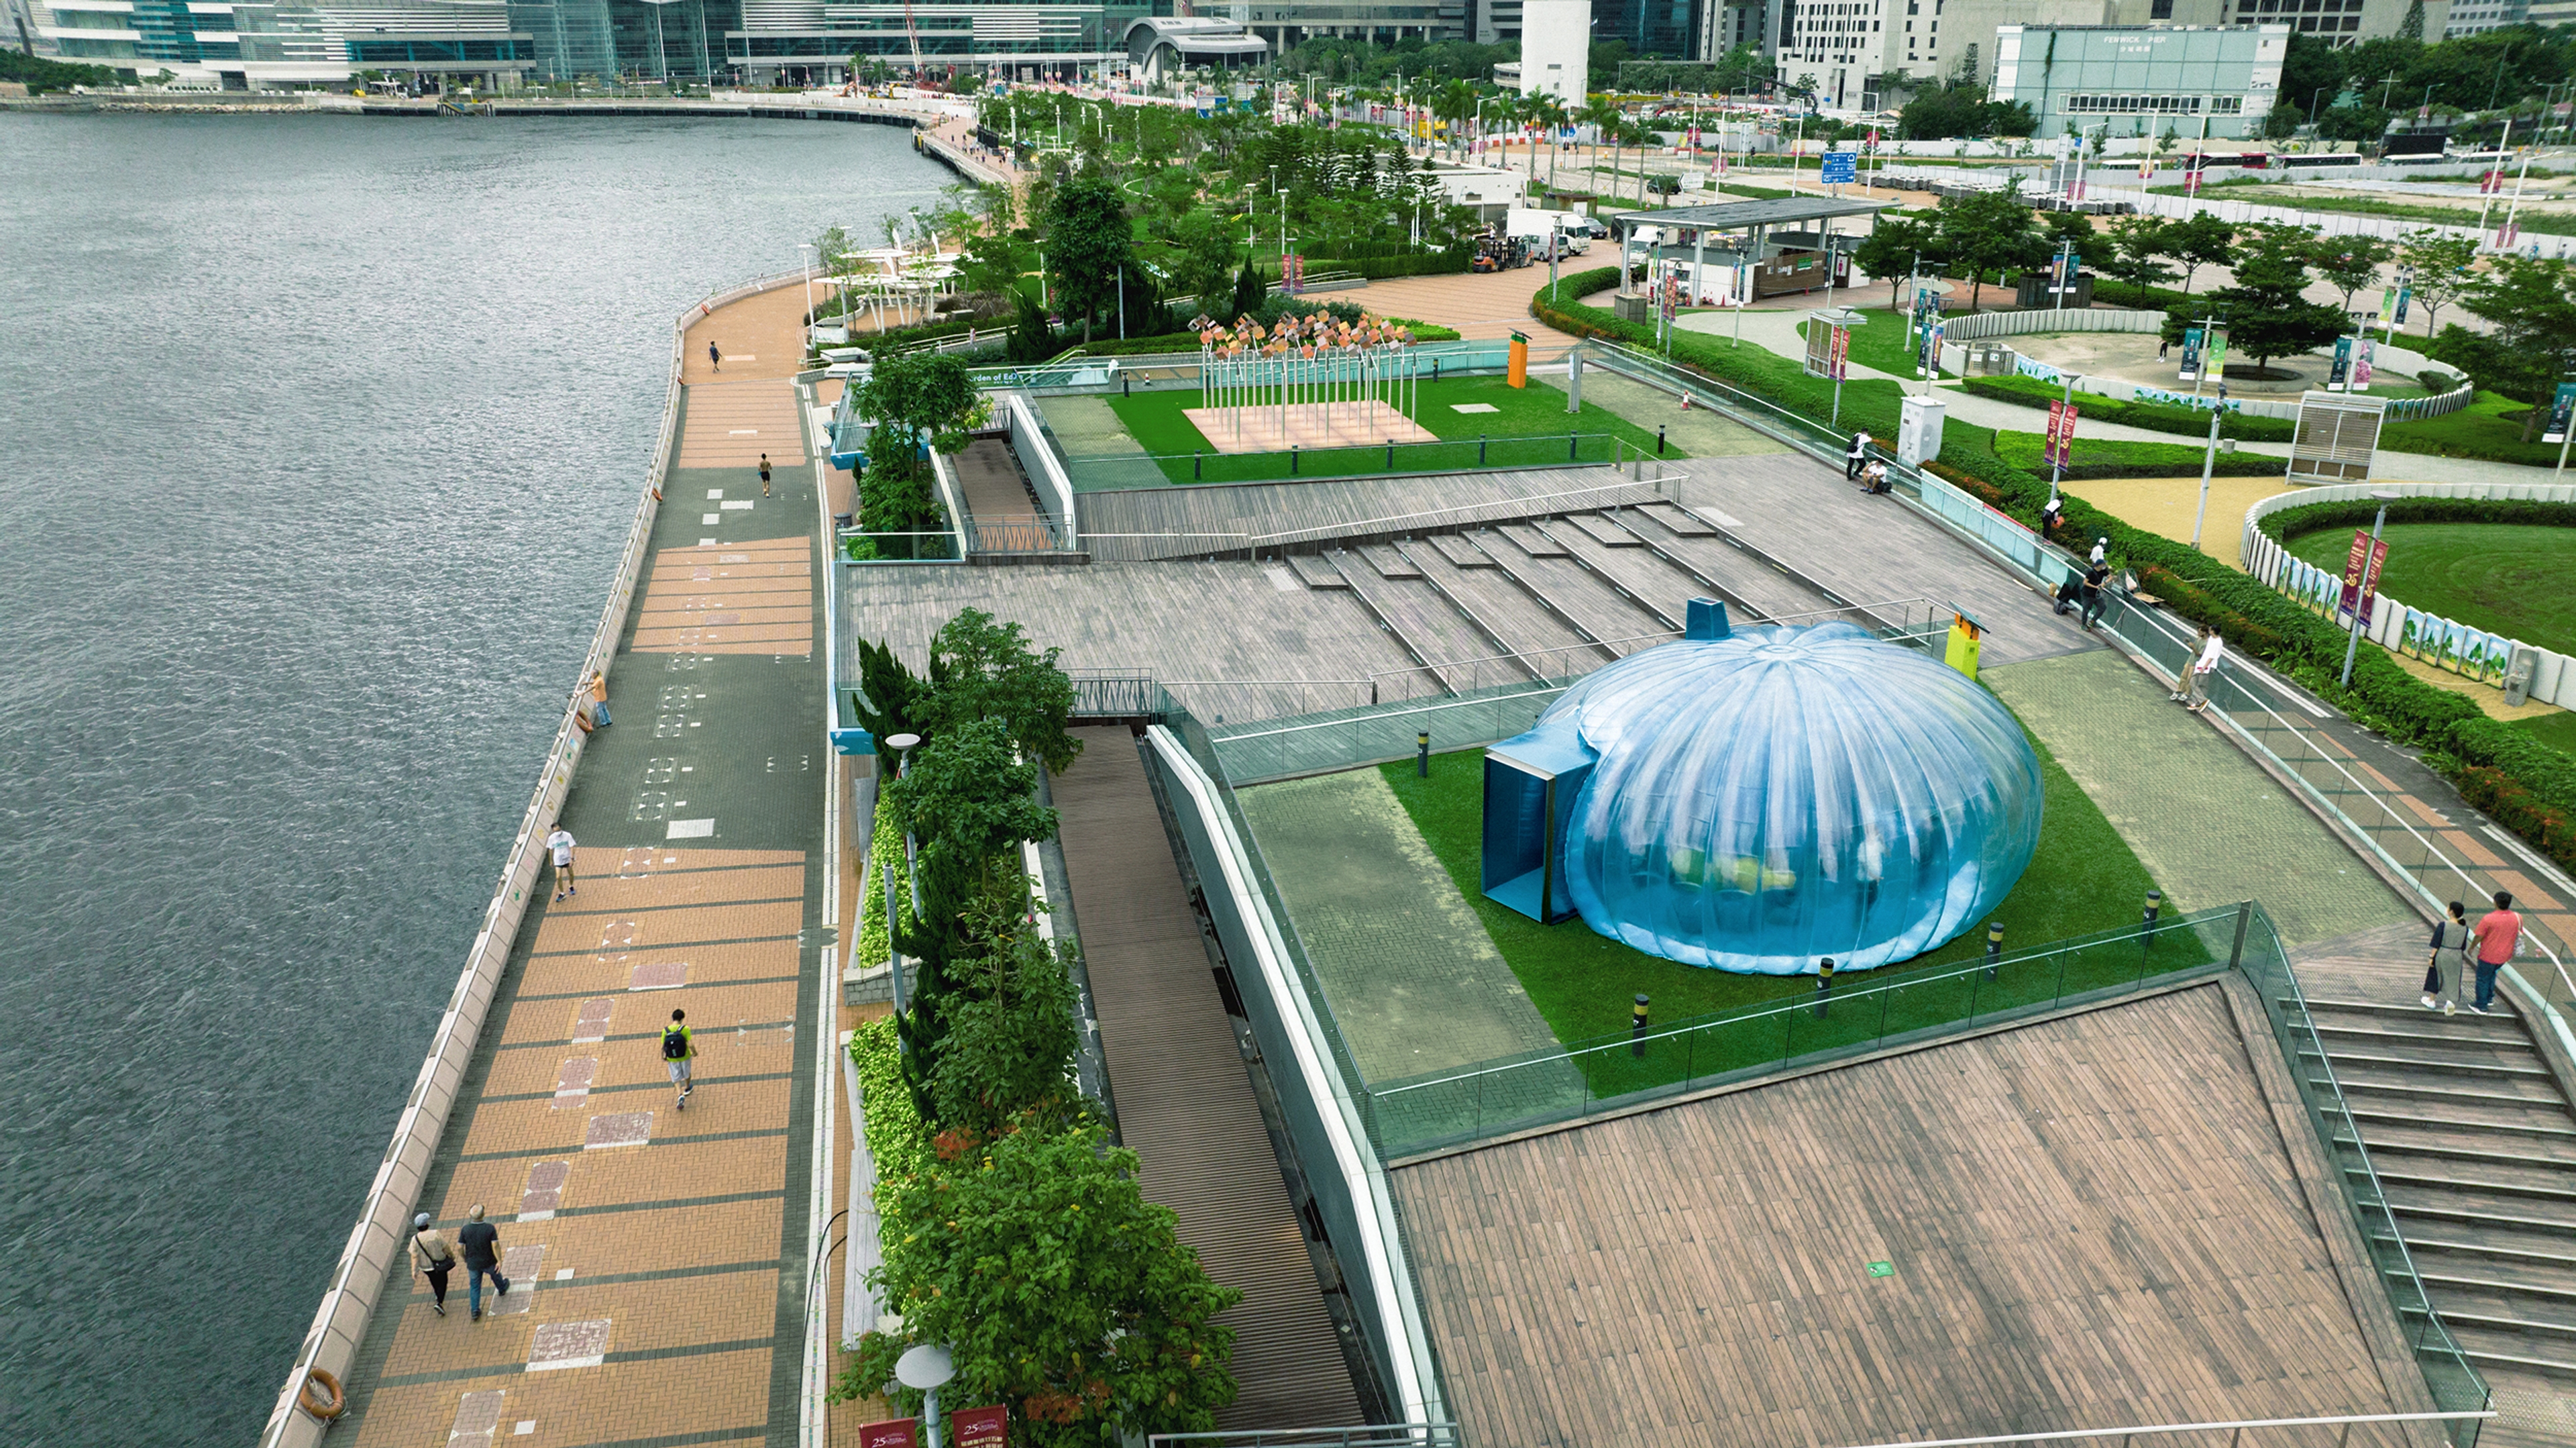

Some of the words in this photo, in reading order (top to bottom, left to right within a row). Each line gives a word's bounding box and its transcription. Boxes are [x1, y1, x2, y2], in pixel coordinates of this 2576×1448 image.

[2104, 36, 2141, 44] FENWICK
[2147, 36, 2167, 44] PIER
[964, 1423, 978, 1435] 25
[871, 1437, 886, 1448] 25
